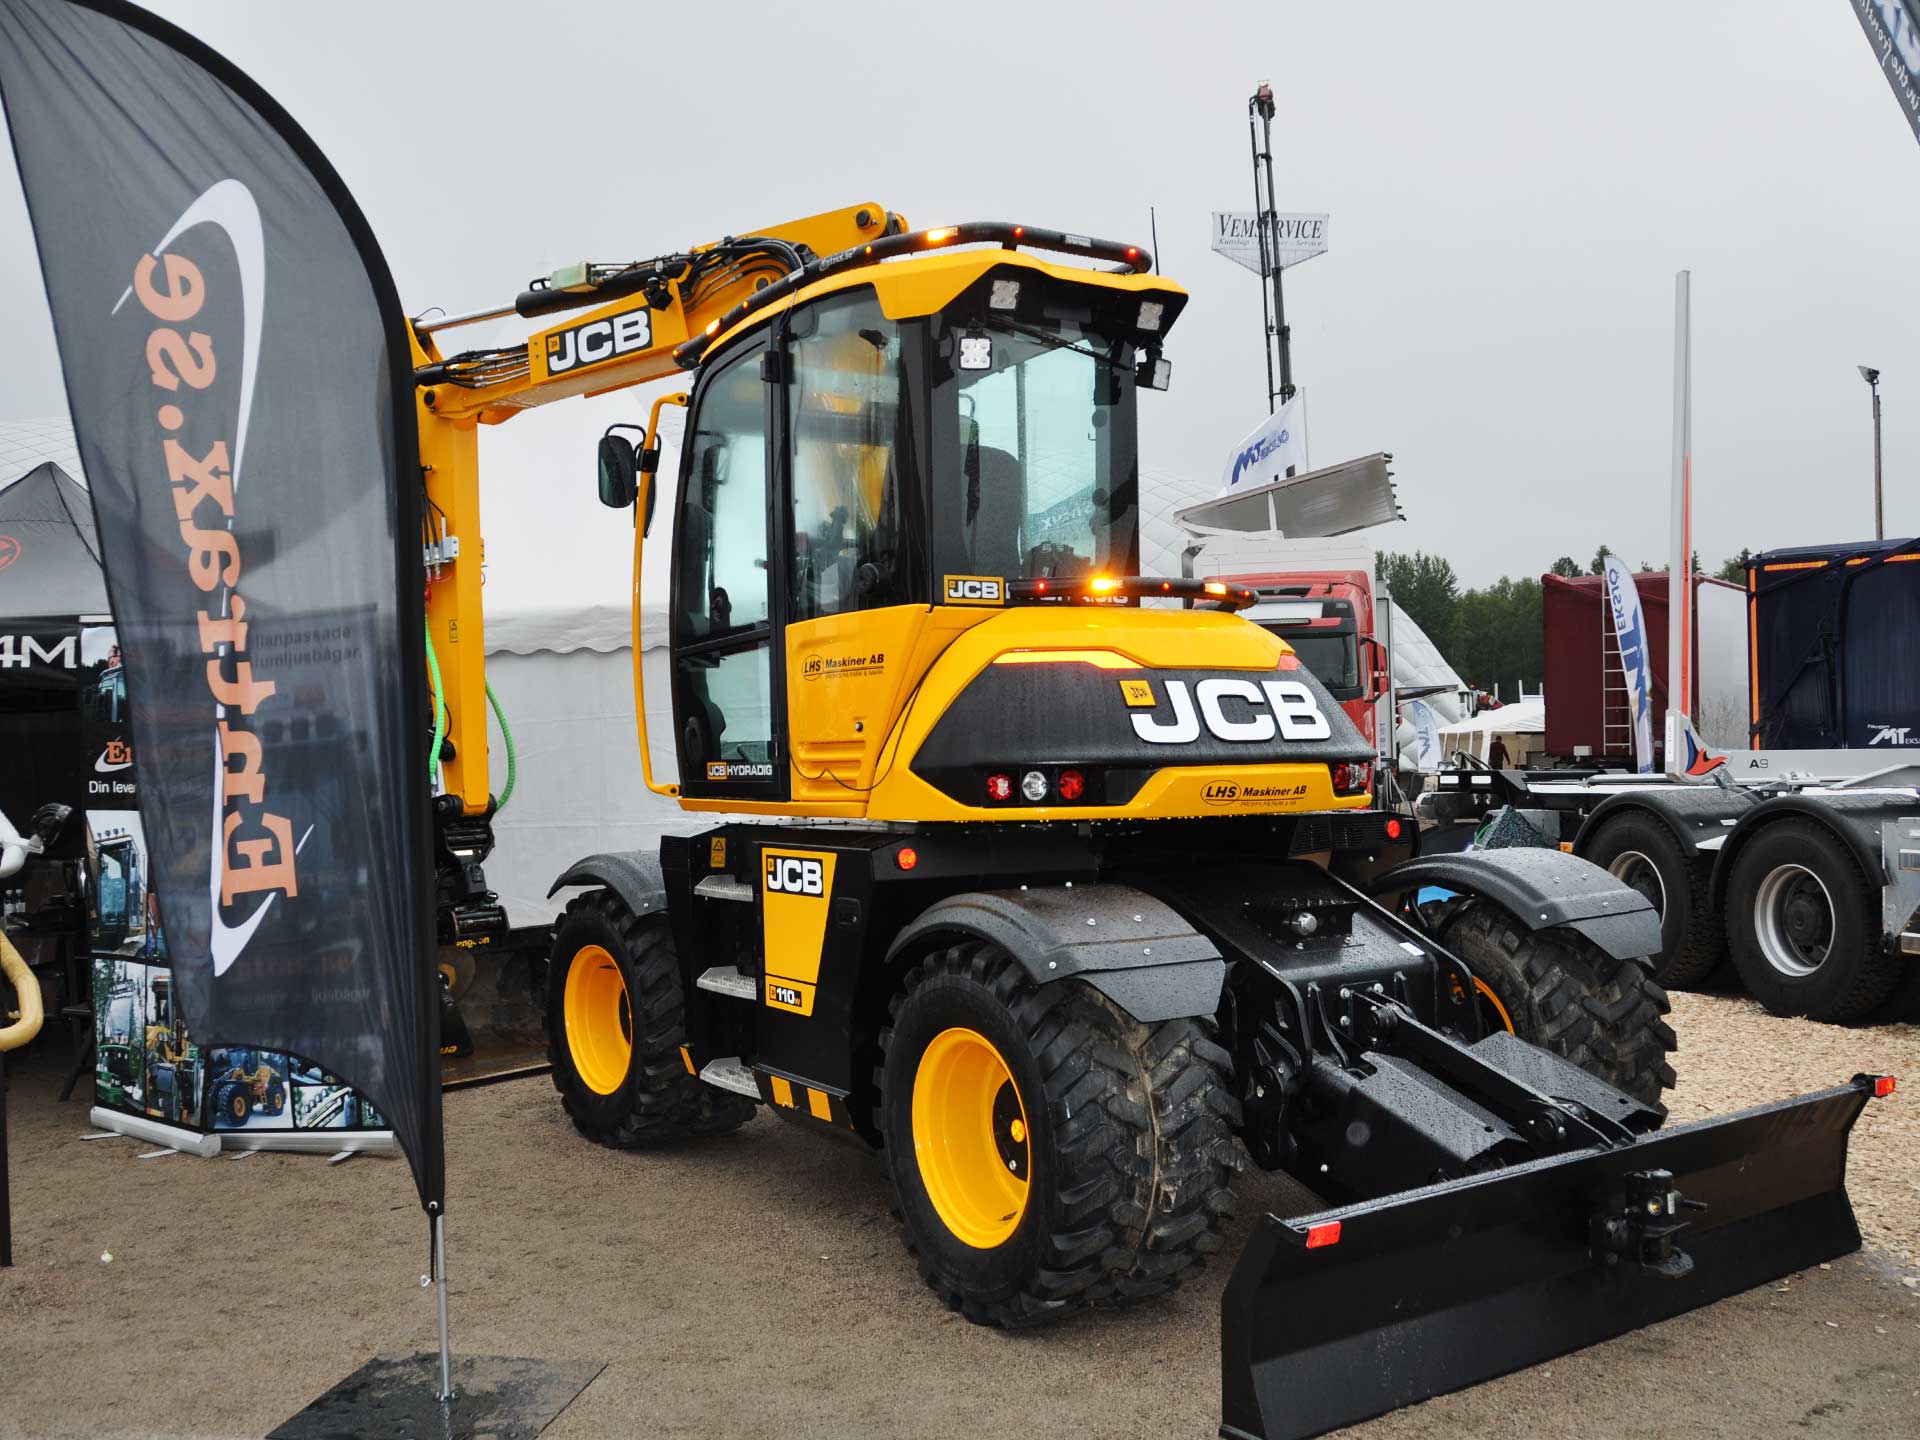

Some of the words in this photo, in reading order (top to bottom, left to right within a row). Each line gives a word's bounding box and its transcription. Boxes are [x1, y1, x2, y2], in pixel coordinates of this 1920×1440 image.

[548, 309, 651, 373] JCB
[948, 580, 999, 599] JCB
[804, 659, 821, 674] LHS
[825, 656, 867, 669] Maskiner
[869, 653, 885, 665] AB
[1130, 678, 1331, 743] JCB
[709, 765, 726, 776] JCB
[726, 764, 773, 776] HYDRADIG
[88, 781, 110, 793] Din
[1205, 786, 1238, 798] LHS
[1242, 786, 1291, 797] Maskiner
[1293, 785, 1307, 795] AB
[767, 858, 823, 895] JCB
